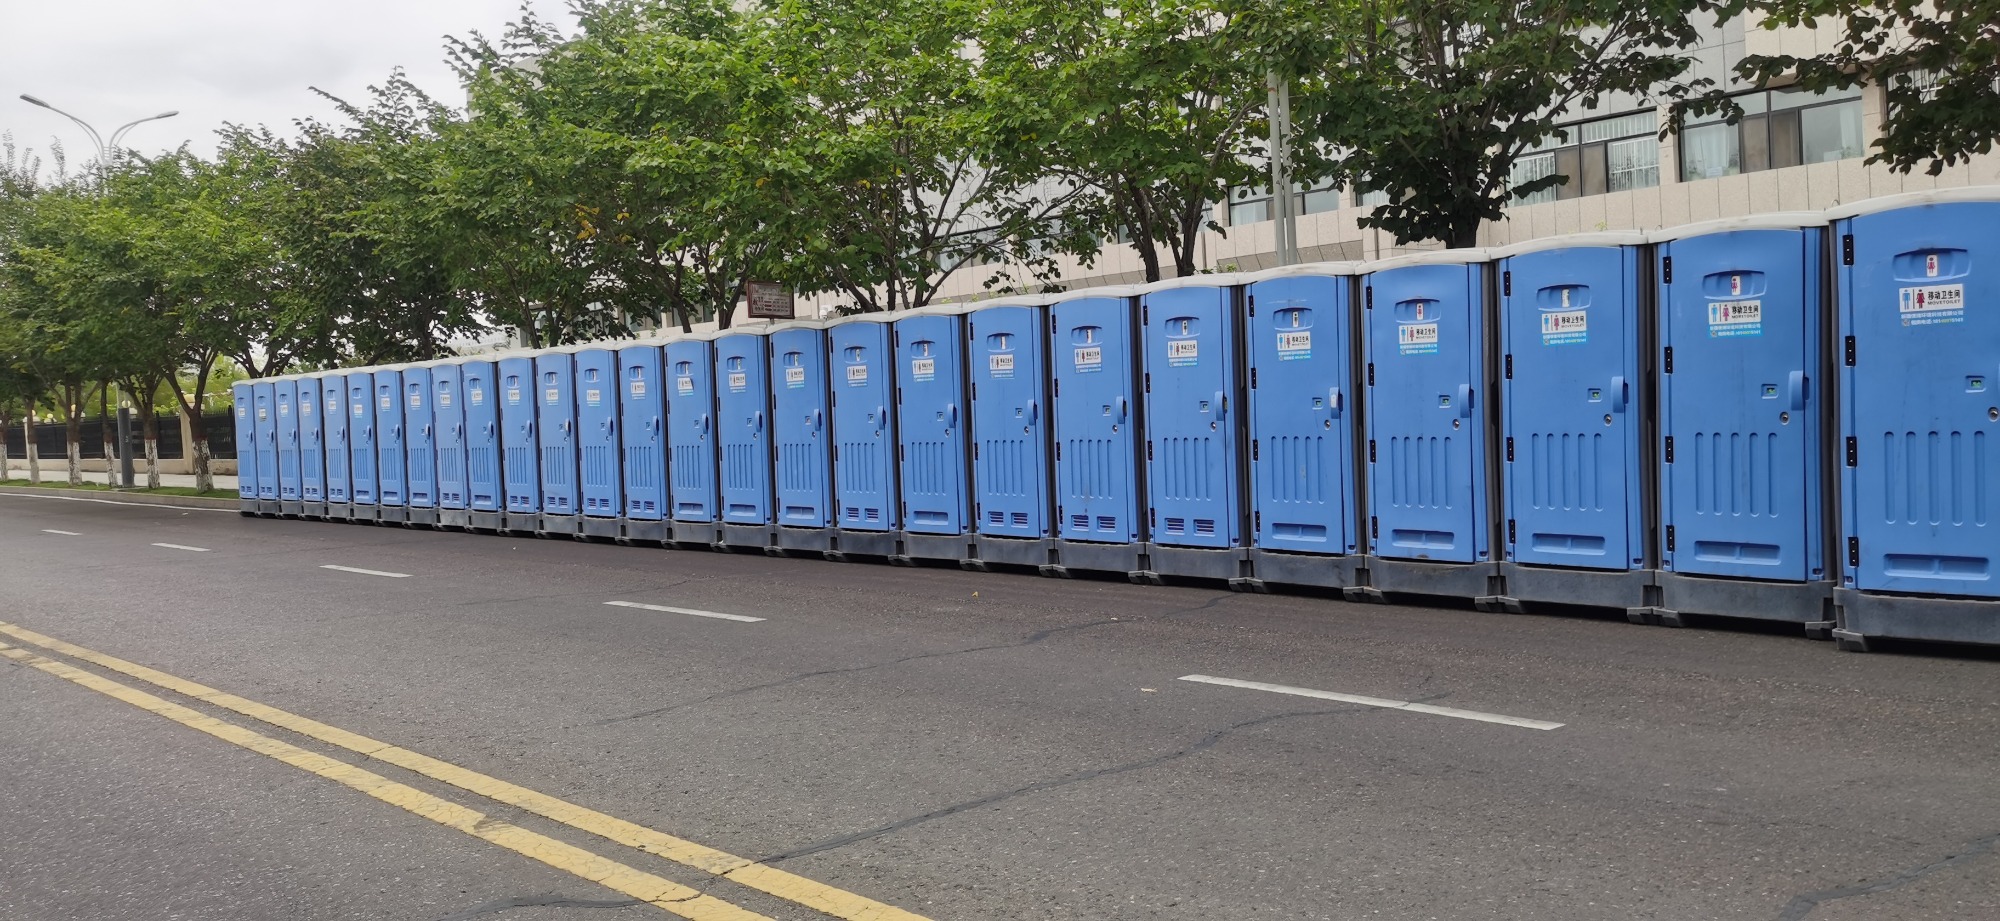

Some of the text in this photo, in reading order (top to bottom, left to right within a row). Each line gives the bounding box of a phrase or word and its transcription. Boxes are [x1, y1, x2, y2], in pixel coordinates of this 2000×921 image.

[1927, 289, 1961, 301] 移动卫生间
[1731, 305, 1759, 314] 移动卫生间
